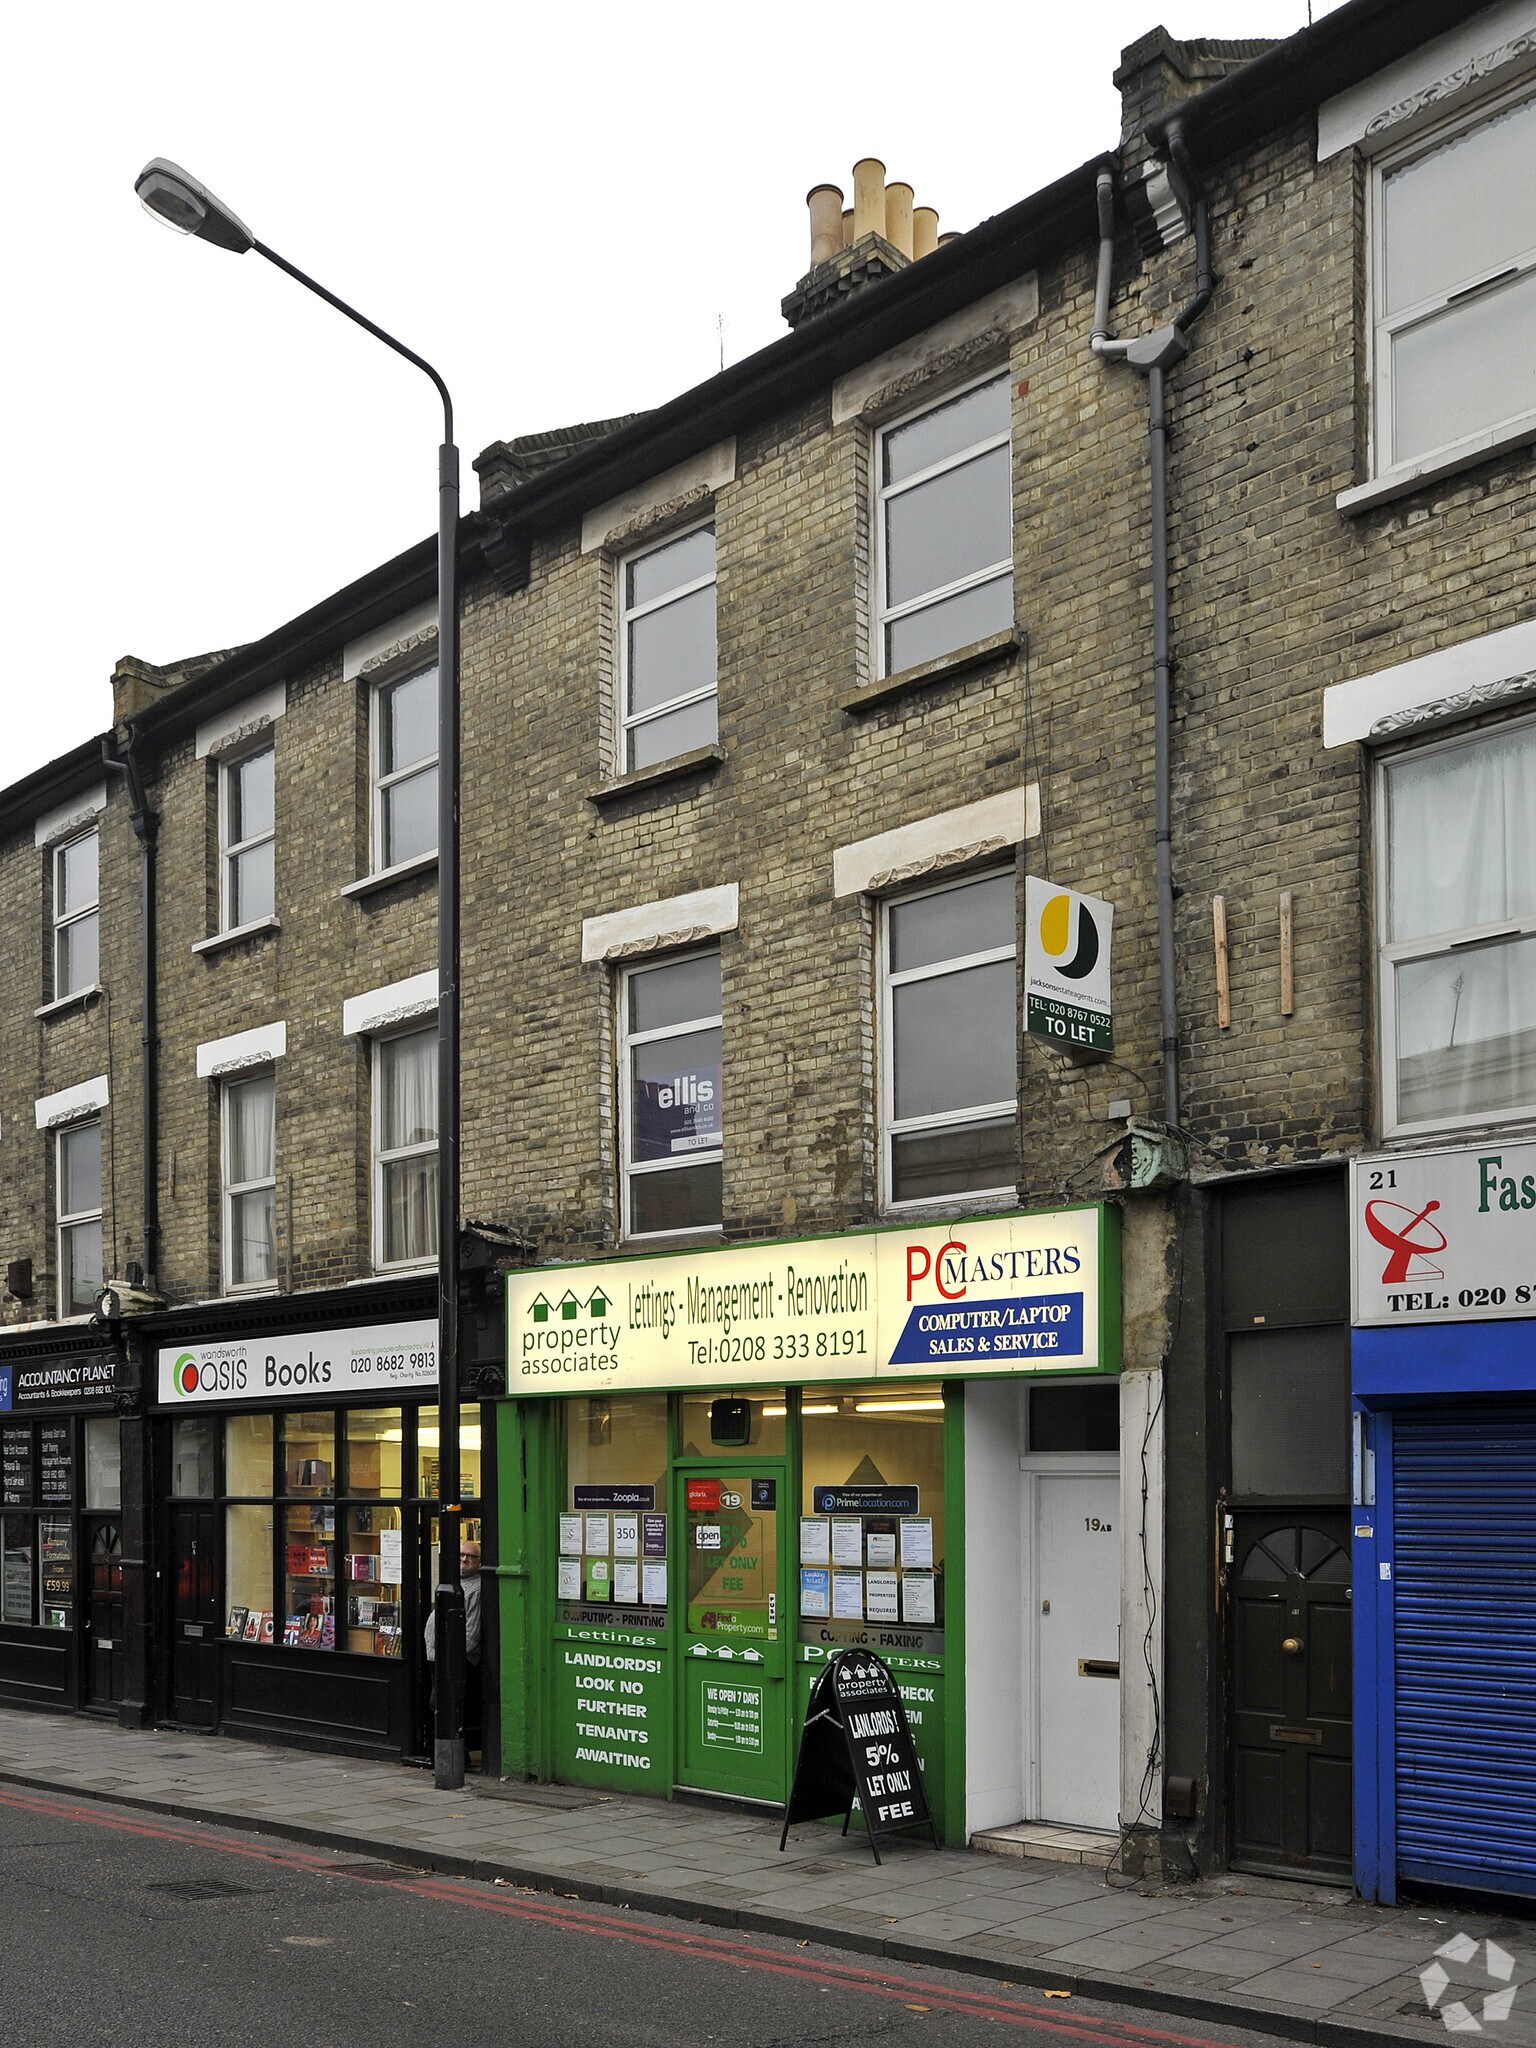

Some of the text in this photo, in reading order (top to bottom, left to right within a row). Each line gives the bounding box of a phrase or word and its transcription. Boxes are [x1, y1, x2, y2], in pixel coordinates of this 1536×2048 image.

[1029, 997, 1111, 1028] TEL: 020 8767 0522
[1045, 1016, 1096, 1043] TO LET
[658, 1074, 714, 1109] ellis
[684, 1103, 714, 1114] and co
[688, 1137, 708, 1146] TO LET
[1369, 1170, 1397, 1190] 21
[629, 1280, 676, 1339] Lettings
[687, 1272, 774, 1335] Management
[788, 1259, 868, 1317] Renovation
[1387, 1284, 1536, 1312] TEL: 020 8
[918, 1304, 1072, 1332] COMPUTER/LAPTOP
[522, 1321, 622, 1355] property
[772, 1332, 810, 1360] 333
[815, 1328, 868, 1357] 8191
[929, 1332, 1059, 1355] SALES & SERVICE
[200, 1347, 247, 1360] wandsworth
[351, 1352, 436, 1374] 020 8682 9813
[264, 1352, 332, 1387] Books
[521, 1352, 618, 1376] associates
[18, 1368, 81, 1388] ACCOUNTANCY
[18, 1390, 46, 1400] Accountants
[46, 1390, 50, 1398] &
[50, 1388, 82, 1398] Bookkeepers
[722, 1494, 740, 1506] 19
[616, 1528, 635, 1540] 350
[698, 1530, 719, 1542] open
[720, 1524, 747, 1549] 5%
[707, 1555, 757, 1569] LET ONLY
[46, 1580, 70, 1592] £59.99
[722, 1577, 744, 1591] FEE
[564, 1610, 665, 1628] CPUTING PRINTING
[568, 1629, 657, 1646] Lettings
[880, 1634, 923, 1650] FAXING
[565, 1652, 661, 1674] LANDLORDS!
[576, 1676, 644, 1695] LOOK NO
[838, 1678, 886, 1692] property
[840, 1686, 888, 1698] associates
[899, 1686, 934, 1702] HECK
[707, 1688, 759, 1705] WE OPEN 7 DAYS
[577, 1698, 647, 1718] FURTHER
[576, 1722, 649, 1744] TENANTS
[848, 1709, 900, 1739] LANLORDS!
[576, 1747, 650, 1769] AWAITING
[866, 1743, 899, 1767] 5%
[866, 1770, 911, 1797] LET ONLY
[878, 1802, 914, 1821] FEE
